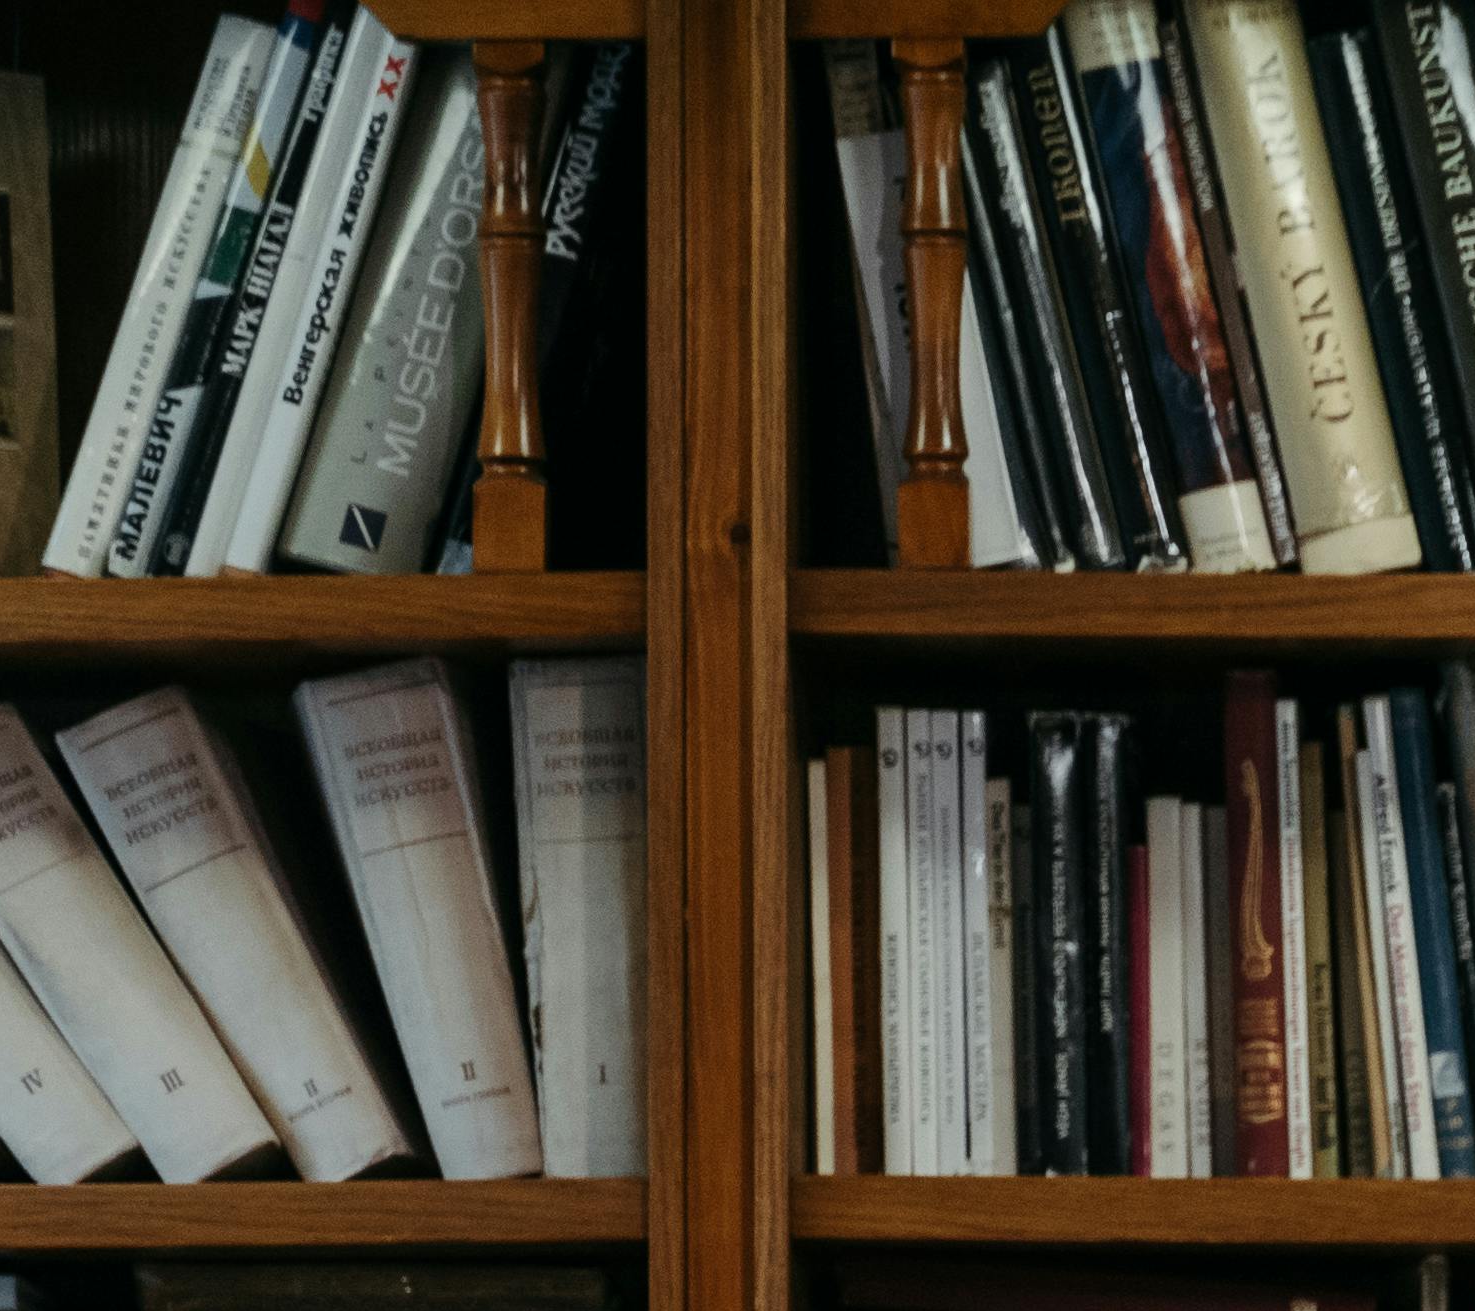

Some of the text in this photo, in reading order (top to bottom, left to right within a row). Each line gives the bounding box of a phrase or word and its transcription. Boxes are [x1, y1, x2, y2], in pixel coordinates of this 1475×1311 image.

[279, 52, 408, 408] Венгерская живопись XX
[218, 200, 297, 380] МАРК ШАГАЛ
[121, 300, 170, 413] МИРОВОГО
[1272, 253, 1363, 430] ČESKÝ
[361, 291, 467, 479] MUSÉE
[110, 392, 183, 563] МАЛЕВИЧ
[1370, 771, 1393, 835] Alfred
[1378, 838, 1399, 893] Frank
[1386, 902, 1404, 941] Der
[1391, 945, 1410, 998] Maler
[20, 1069, 46, 1097] IV
[159, 1068, 185, 1095] III
[301, 1079, 320, 1099] II
[460, 1060, 479, 1082] II
[1154, 1041, 1175, 1153] DEGAS
